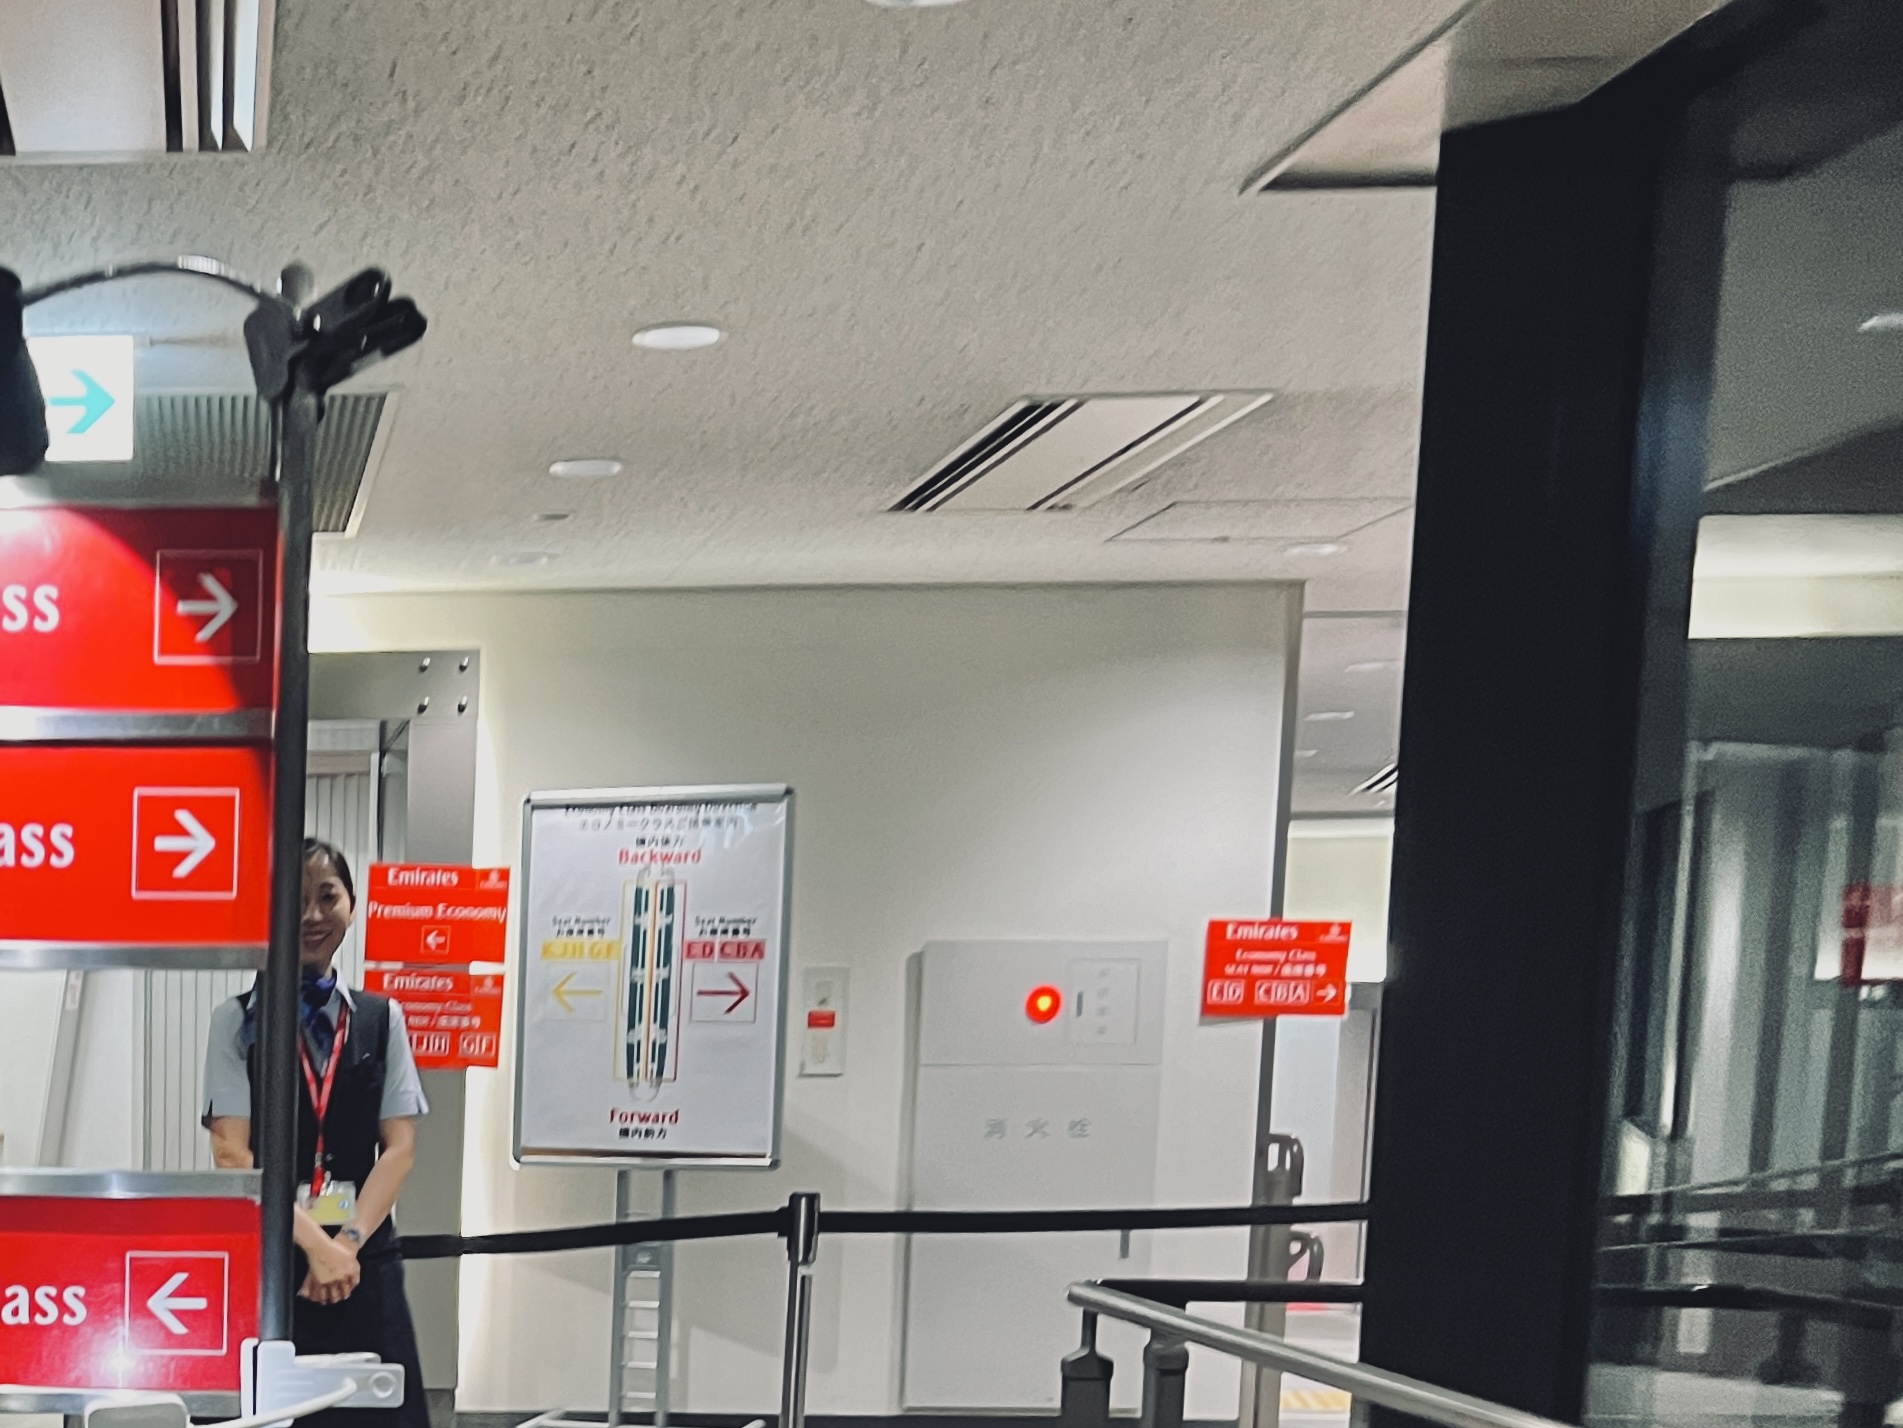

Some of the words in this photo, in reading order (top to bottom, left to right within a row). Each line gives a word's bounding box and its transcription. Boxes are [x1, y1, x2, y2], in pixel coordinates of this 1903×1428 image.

[618, 848, 702, 866] Backward
[387, 866, 459, 887] Emirates
[368, 901, 434, 919] Premium
[437, 902, 508, 925] Economy
[1226, 922, 1299, 941] Emirates
[382, 972, 454, 991] Emirates
[609, 1107, 680, 1125] Forward
